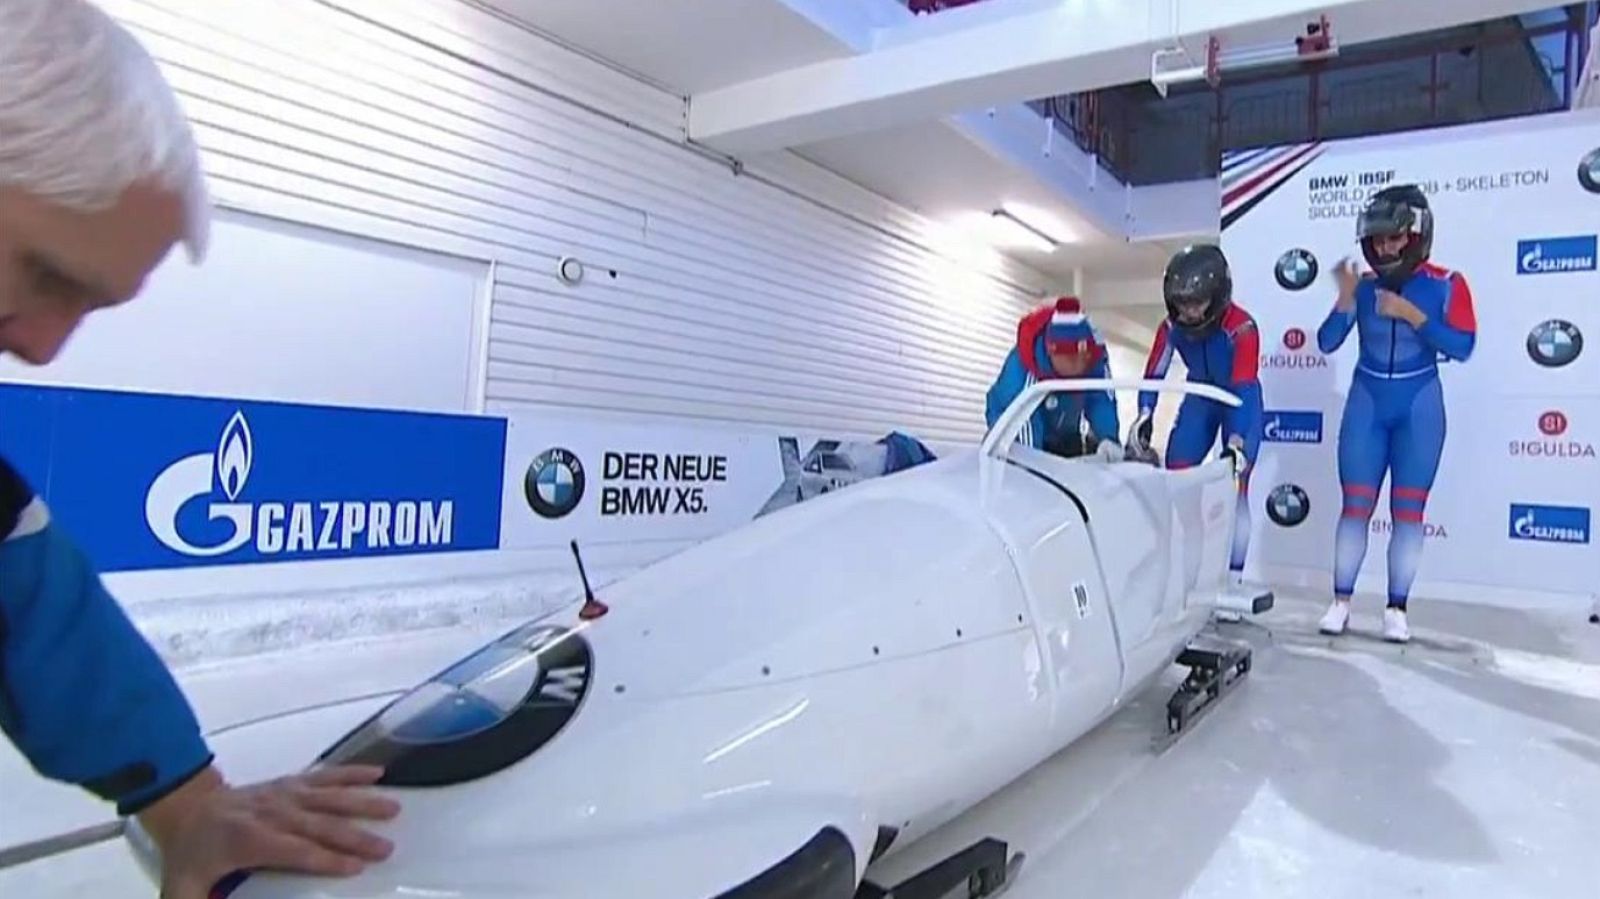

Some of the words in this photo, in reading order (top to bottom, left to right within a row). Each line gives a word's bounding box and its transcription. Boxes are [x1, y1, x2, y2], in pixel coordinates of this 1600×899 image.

[1308, 174, 1348, 190] BMW
[1359, 170, 1395, 185] IBSF
[1309, 187, 1364, 204] WORLD
[1456, 169, 1549, 193] SKELETON
[1308, 203, 1360, 220] SIGULD
[603, 452, 659, 481] DER
[663, 453, 728, 481] NEUE
[600, 486, 671, 515] BMW
[673, 487, 708, 514] X5.
[256, 499, 454, 553] GAZPROM
